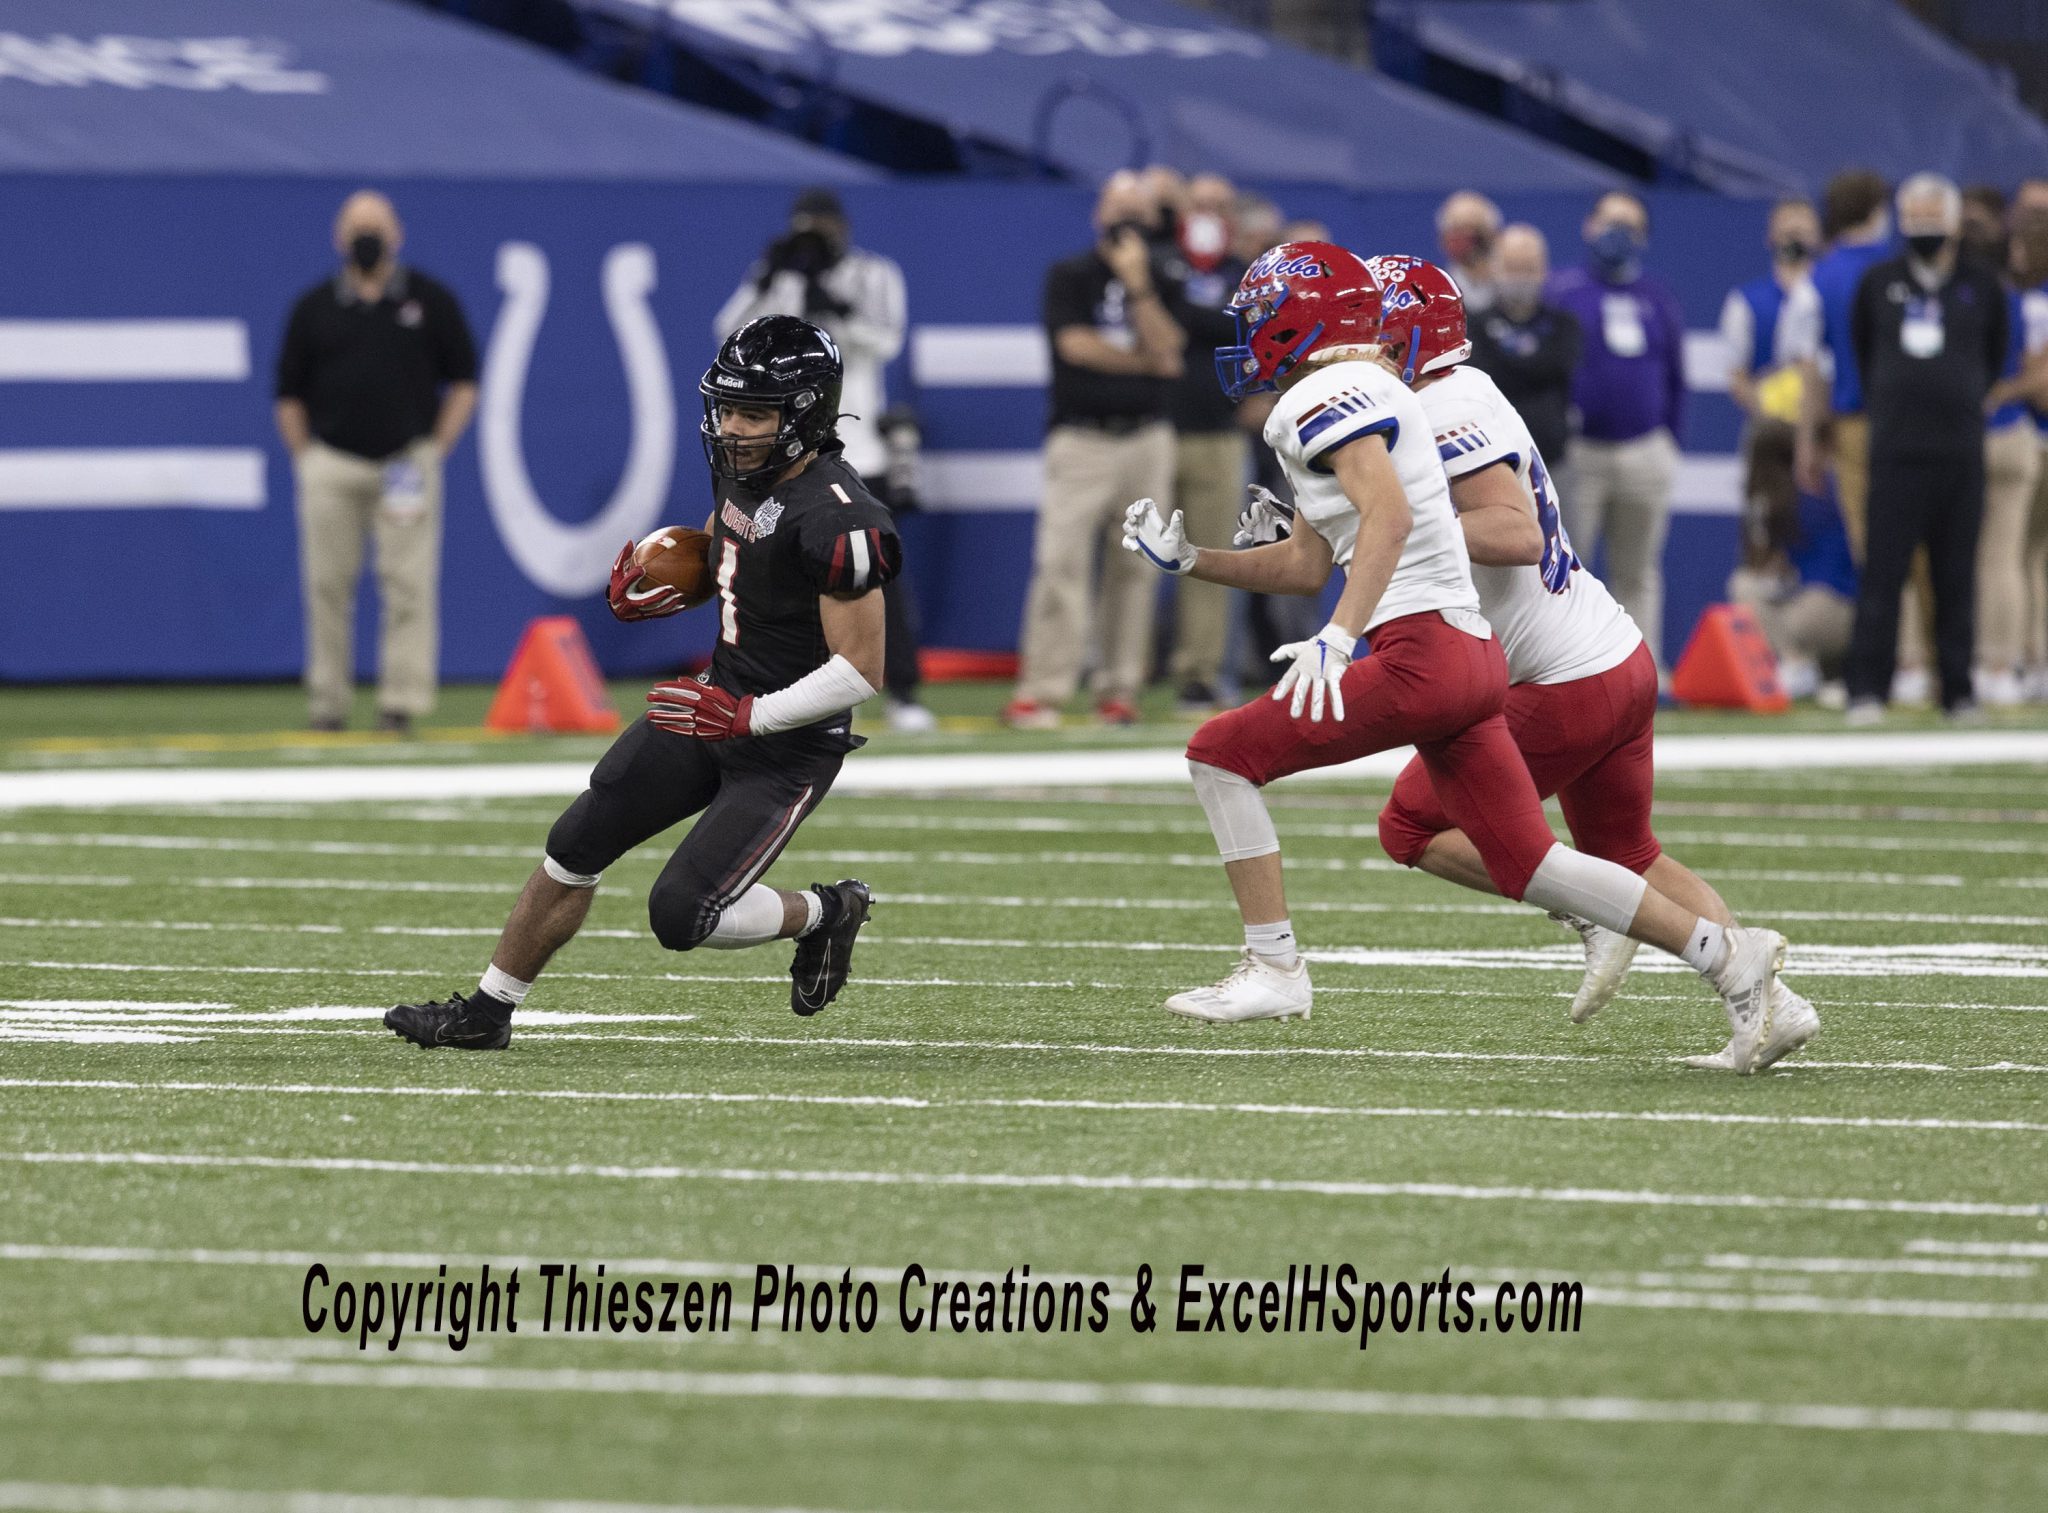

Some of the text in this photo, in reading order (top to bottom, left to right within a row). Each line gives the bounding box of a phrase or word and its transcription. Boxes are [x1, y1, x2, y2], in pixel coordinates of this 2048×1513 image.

[1250, 254, 1322, 282] Webo
[716, 375, 744, 389] Riddell
[720, 497, 756, 544] KNIGHTS
[716, 536, 741, 647] 1
